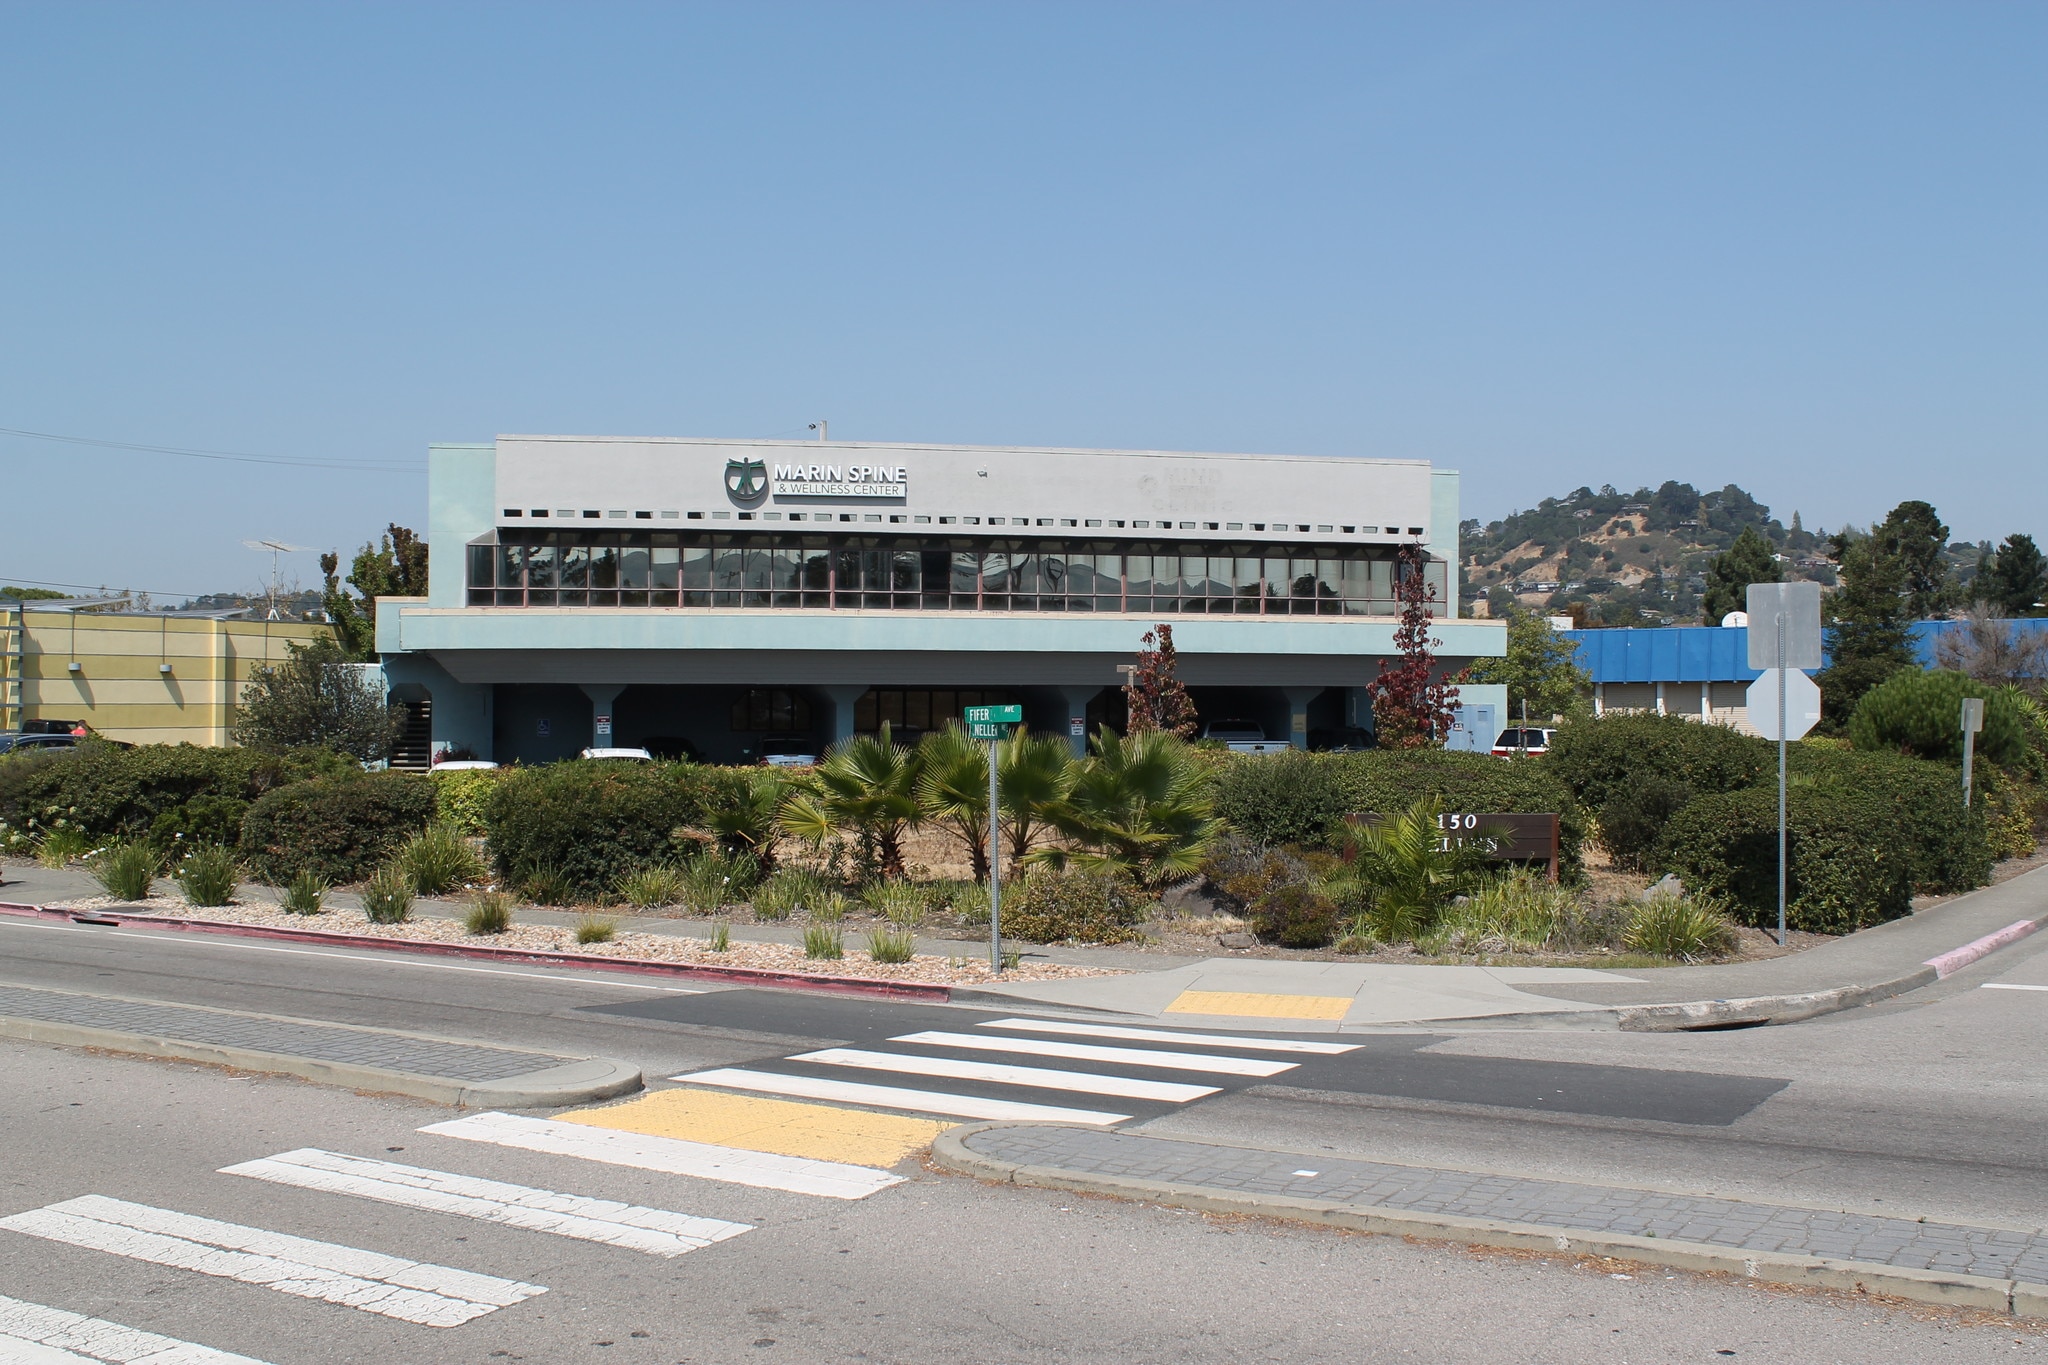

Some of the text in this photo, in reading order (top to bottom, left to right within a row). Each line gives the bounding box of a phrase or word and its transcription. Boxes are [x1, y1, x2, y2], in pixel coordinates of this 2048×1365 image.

[774, 464, 907, 483] MARIN SPINE
[778, 483, 899, 496] & WELLNESS CENTER
[969, 705, 1015, 721] FIFER AVE
[1437, 814, 1477, 830] 150
